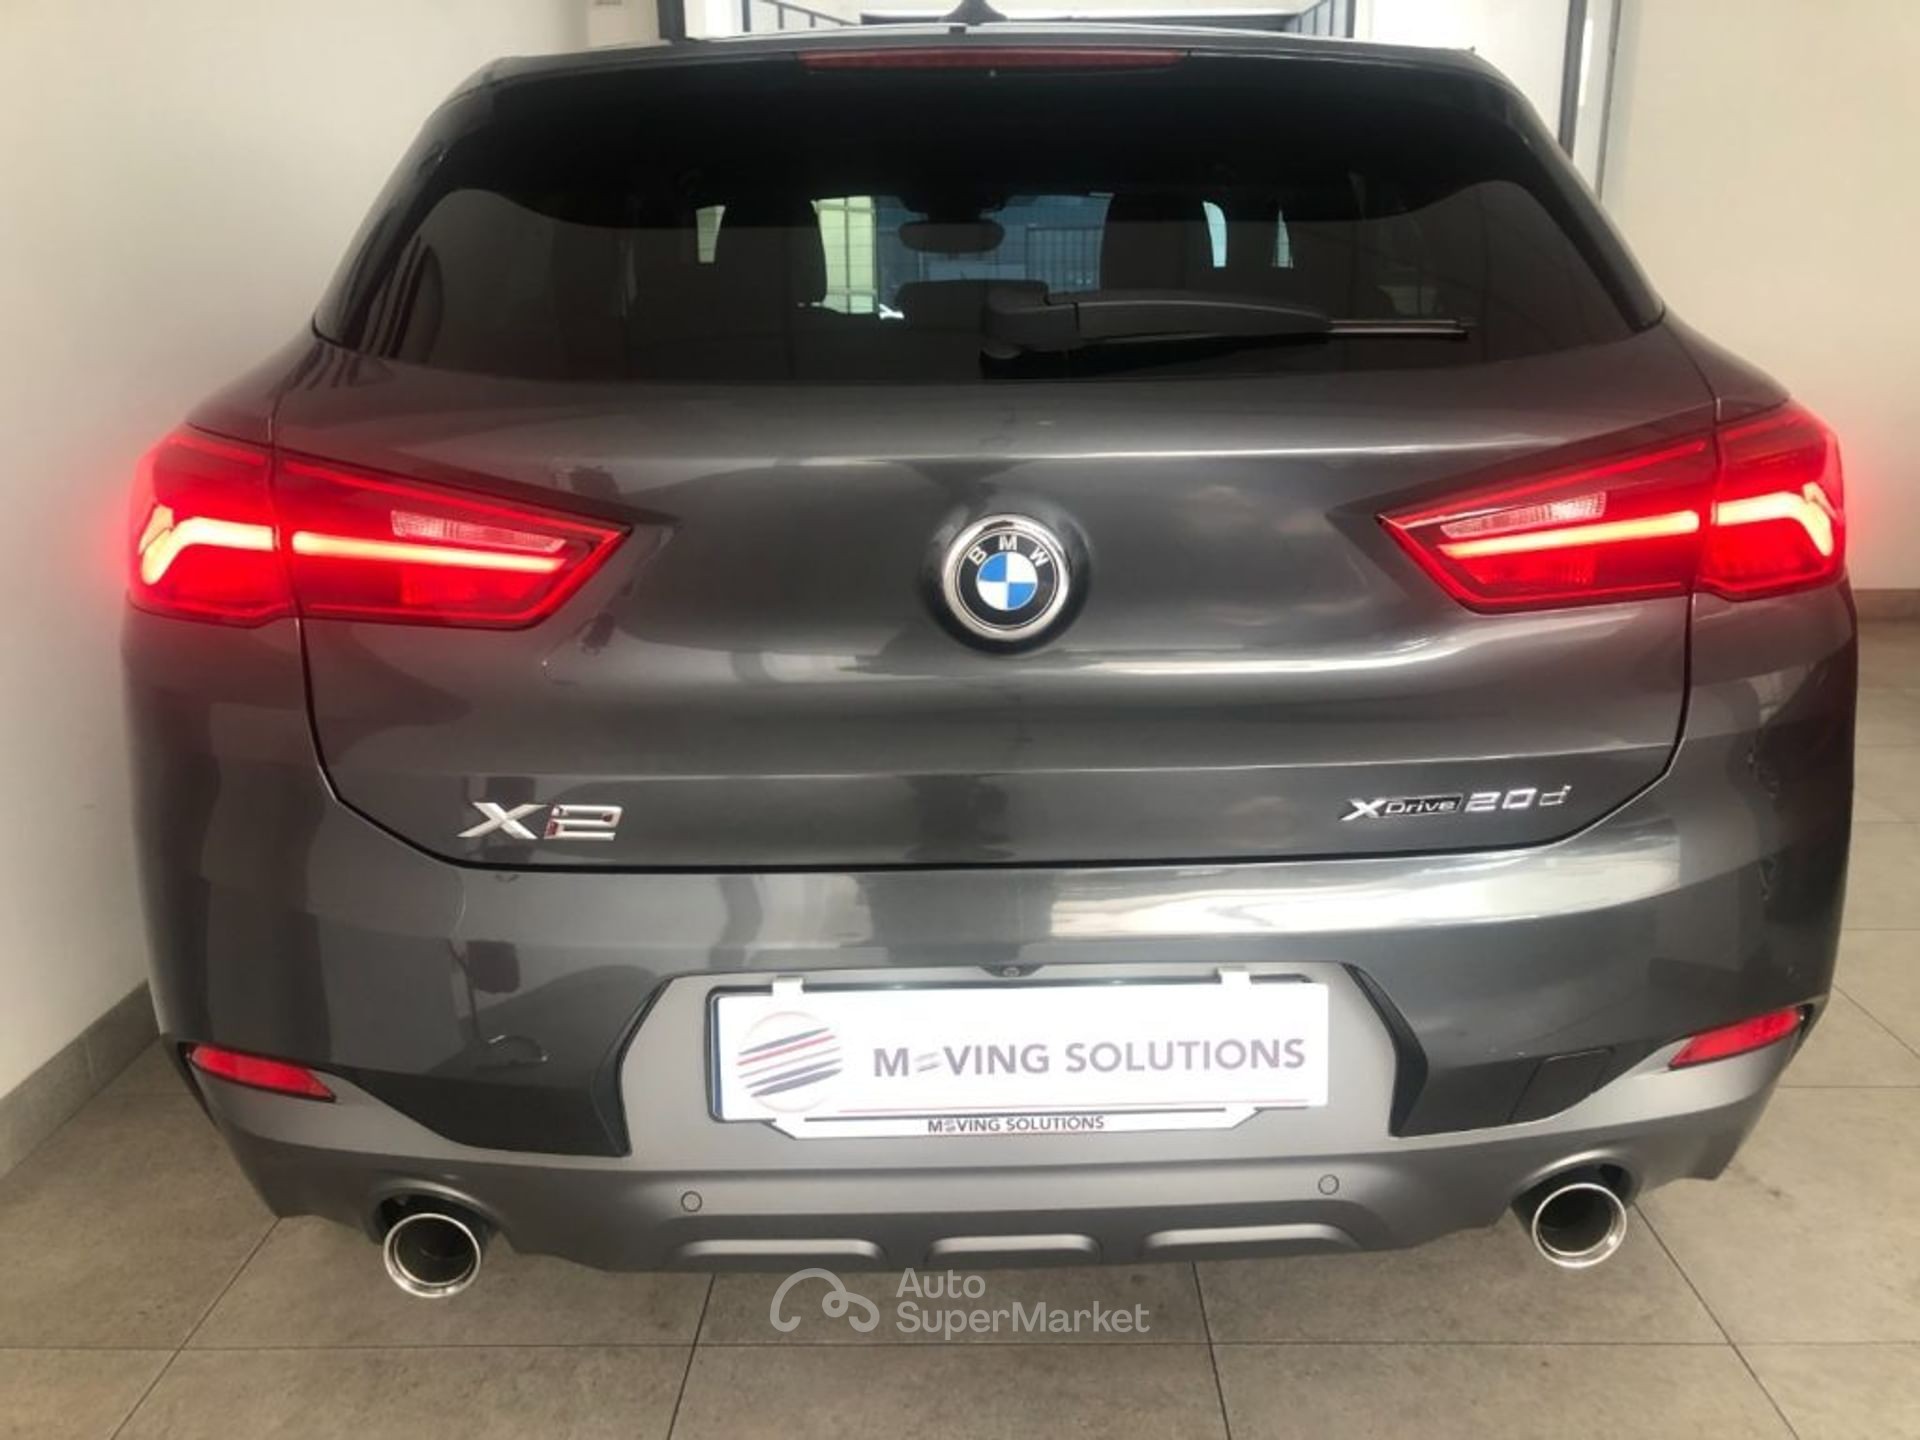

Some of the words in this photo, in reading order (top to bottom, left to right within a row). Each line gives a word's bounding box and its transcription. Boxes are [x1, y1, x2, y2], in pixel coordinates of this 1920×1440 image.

[967, 535, 1050, 567] BMW
[456, 801, 623, 841] X2
[1065, 1038, 1307, 1073] SOLUTIONS
[1006, 1116, 1105, 1132] SOLUTIONS
